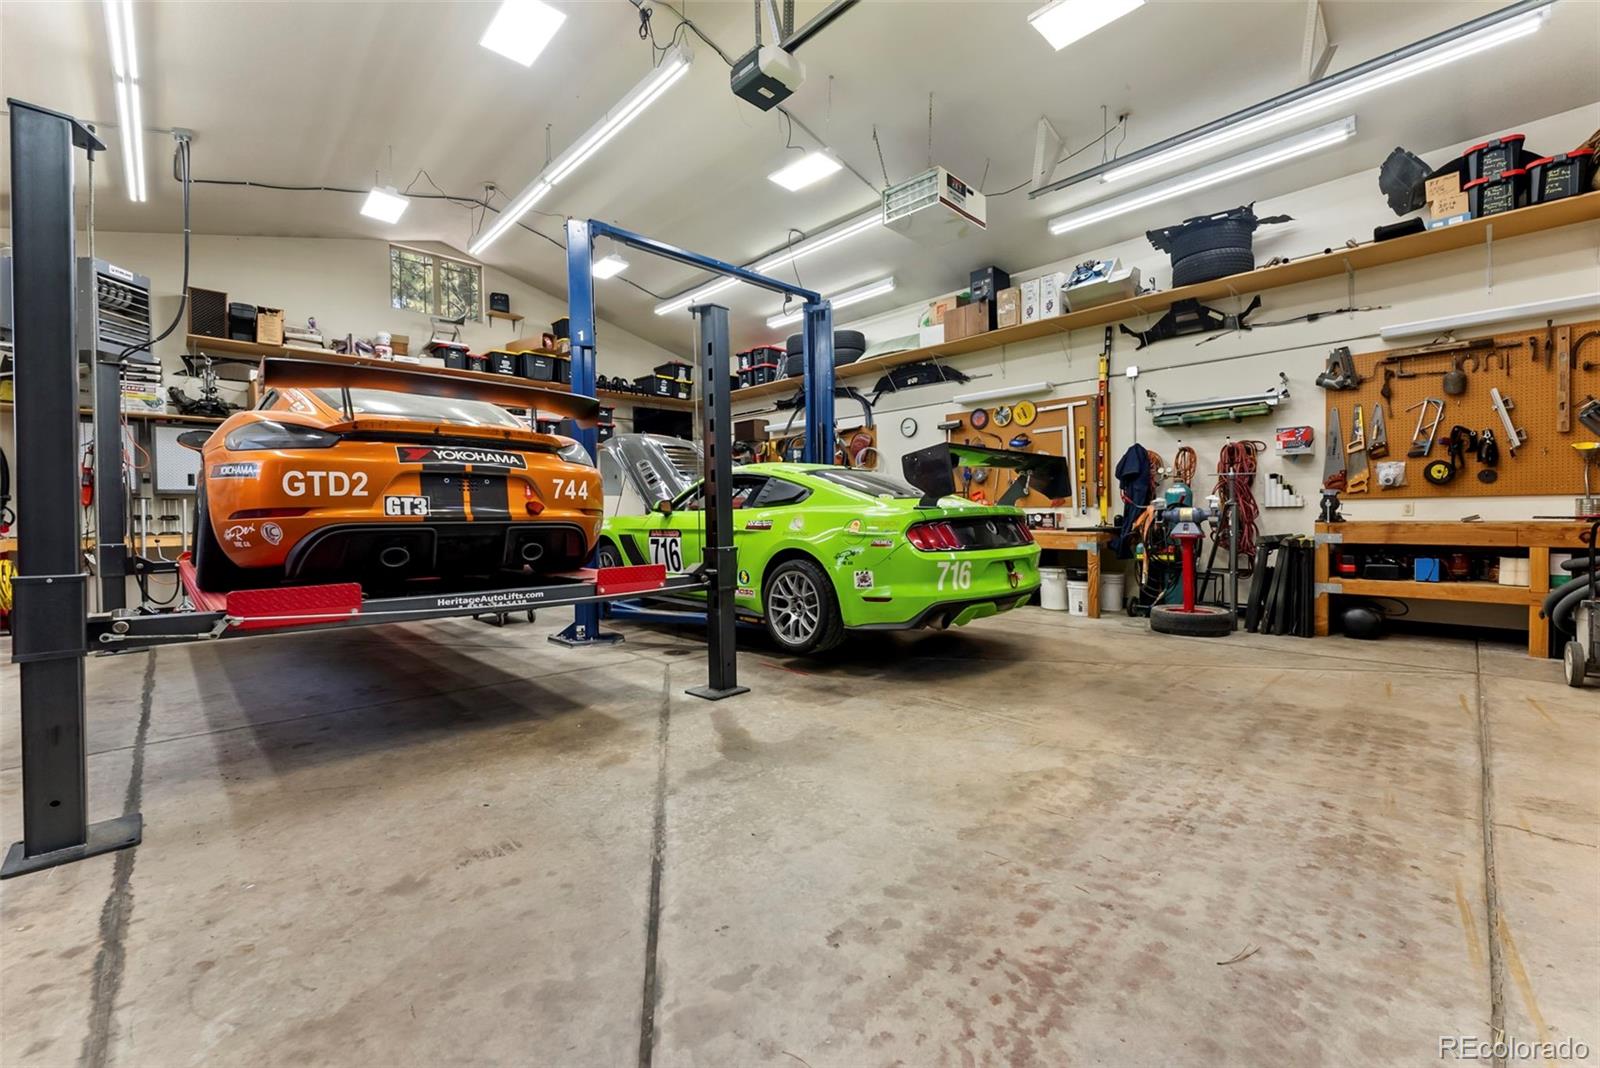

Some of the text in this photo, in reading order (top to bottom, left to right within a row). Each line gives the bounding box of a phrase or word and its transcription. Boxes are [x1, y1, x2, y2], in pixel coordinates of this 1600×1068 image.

[577, 330, 585, 341] 1
[433, 449, 523, 466] YOKOHAMA
[282, 470, 369, 497] GTD2
[552, 478, 589, 500] 744
[385, 496, 428, 516] GT3
[650, 538, 681, 573] 716
[936, 560, 972, 592] 716
[437, 591, 545, 607] HeritageAutoLifts.com
